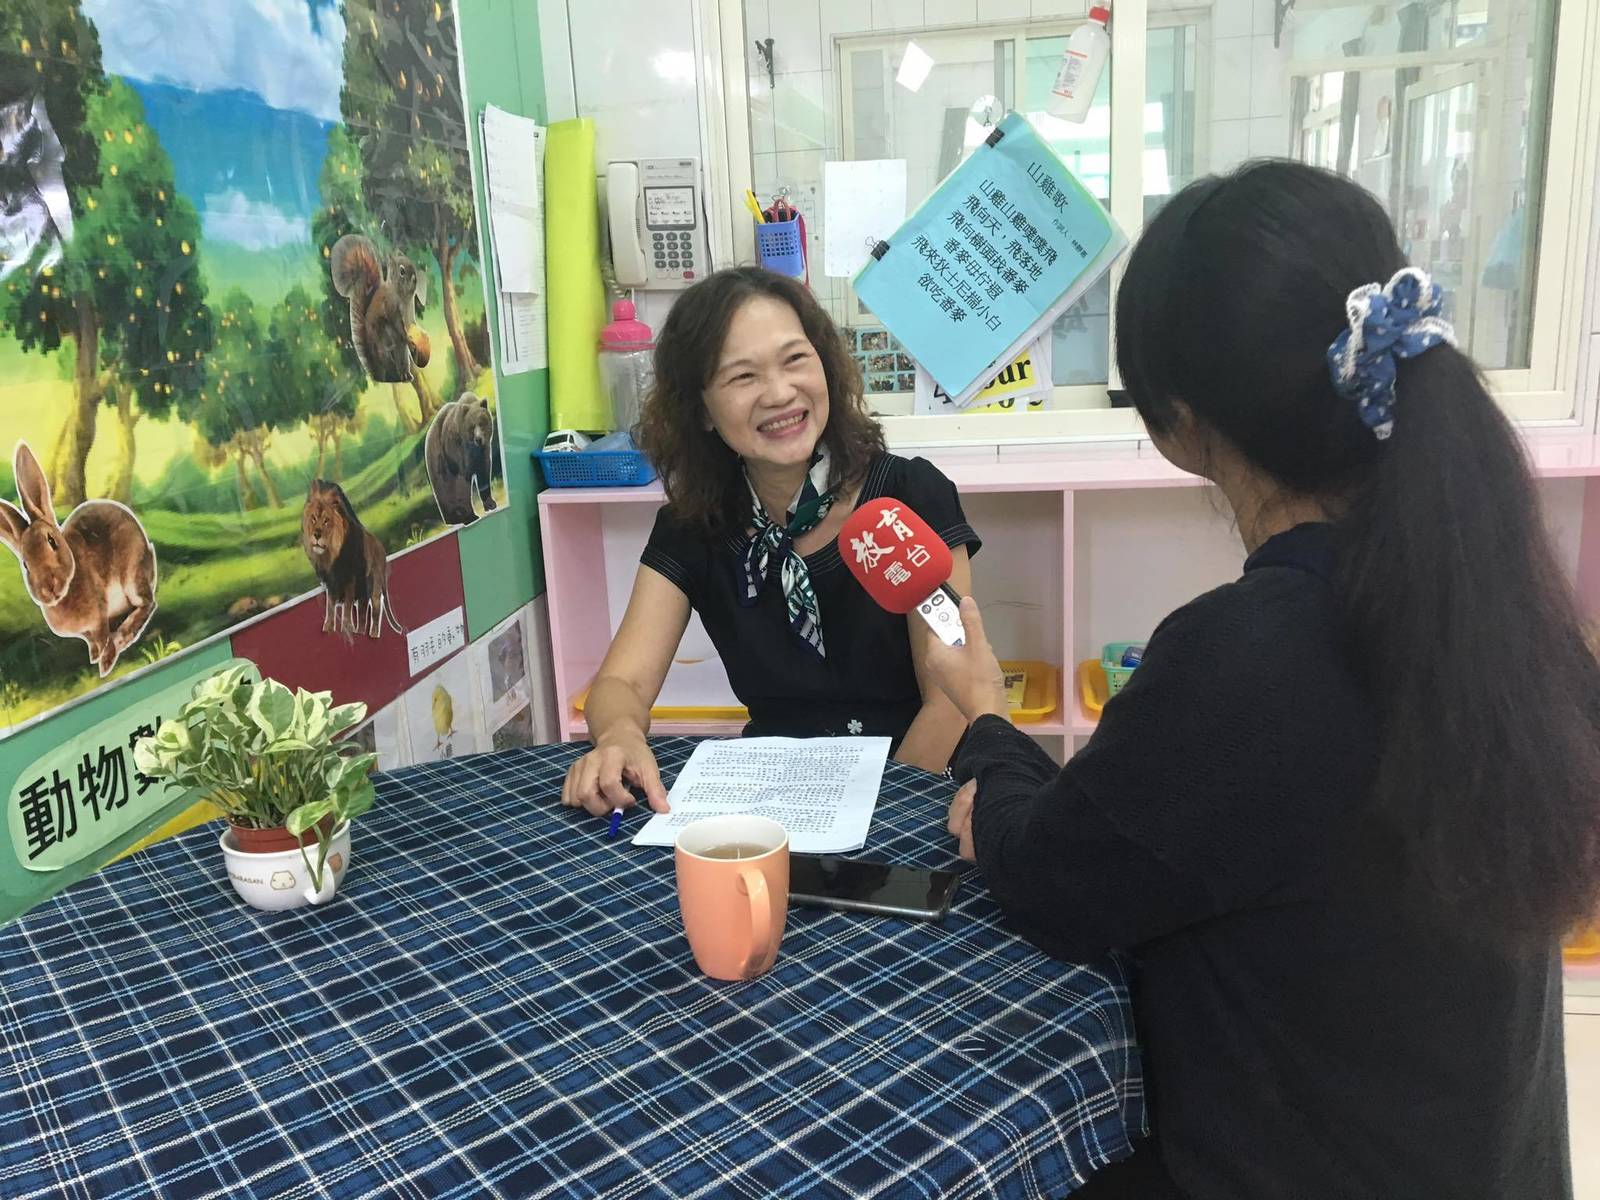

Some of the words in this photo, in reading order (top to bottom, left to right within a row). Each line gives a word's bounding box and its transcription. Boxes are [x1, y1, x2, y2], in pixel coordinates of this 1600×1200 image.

[1026, 161, 1069, 214] 山雞歌
[946, 208, 1030, 296] 飛向樹頭找番麥
[978, 178, 1059, 267] 山雞山雞噗噗飛
[916, 272, 968, 324] 欲吃番麥
[850, 507, 915, 575] 教育
[883, 543, 931, 587] 電台
